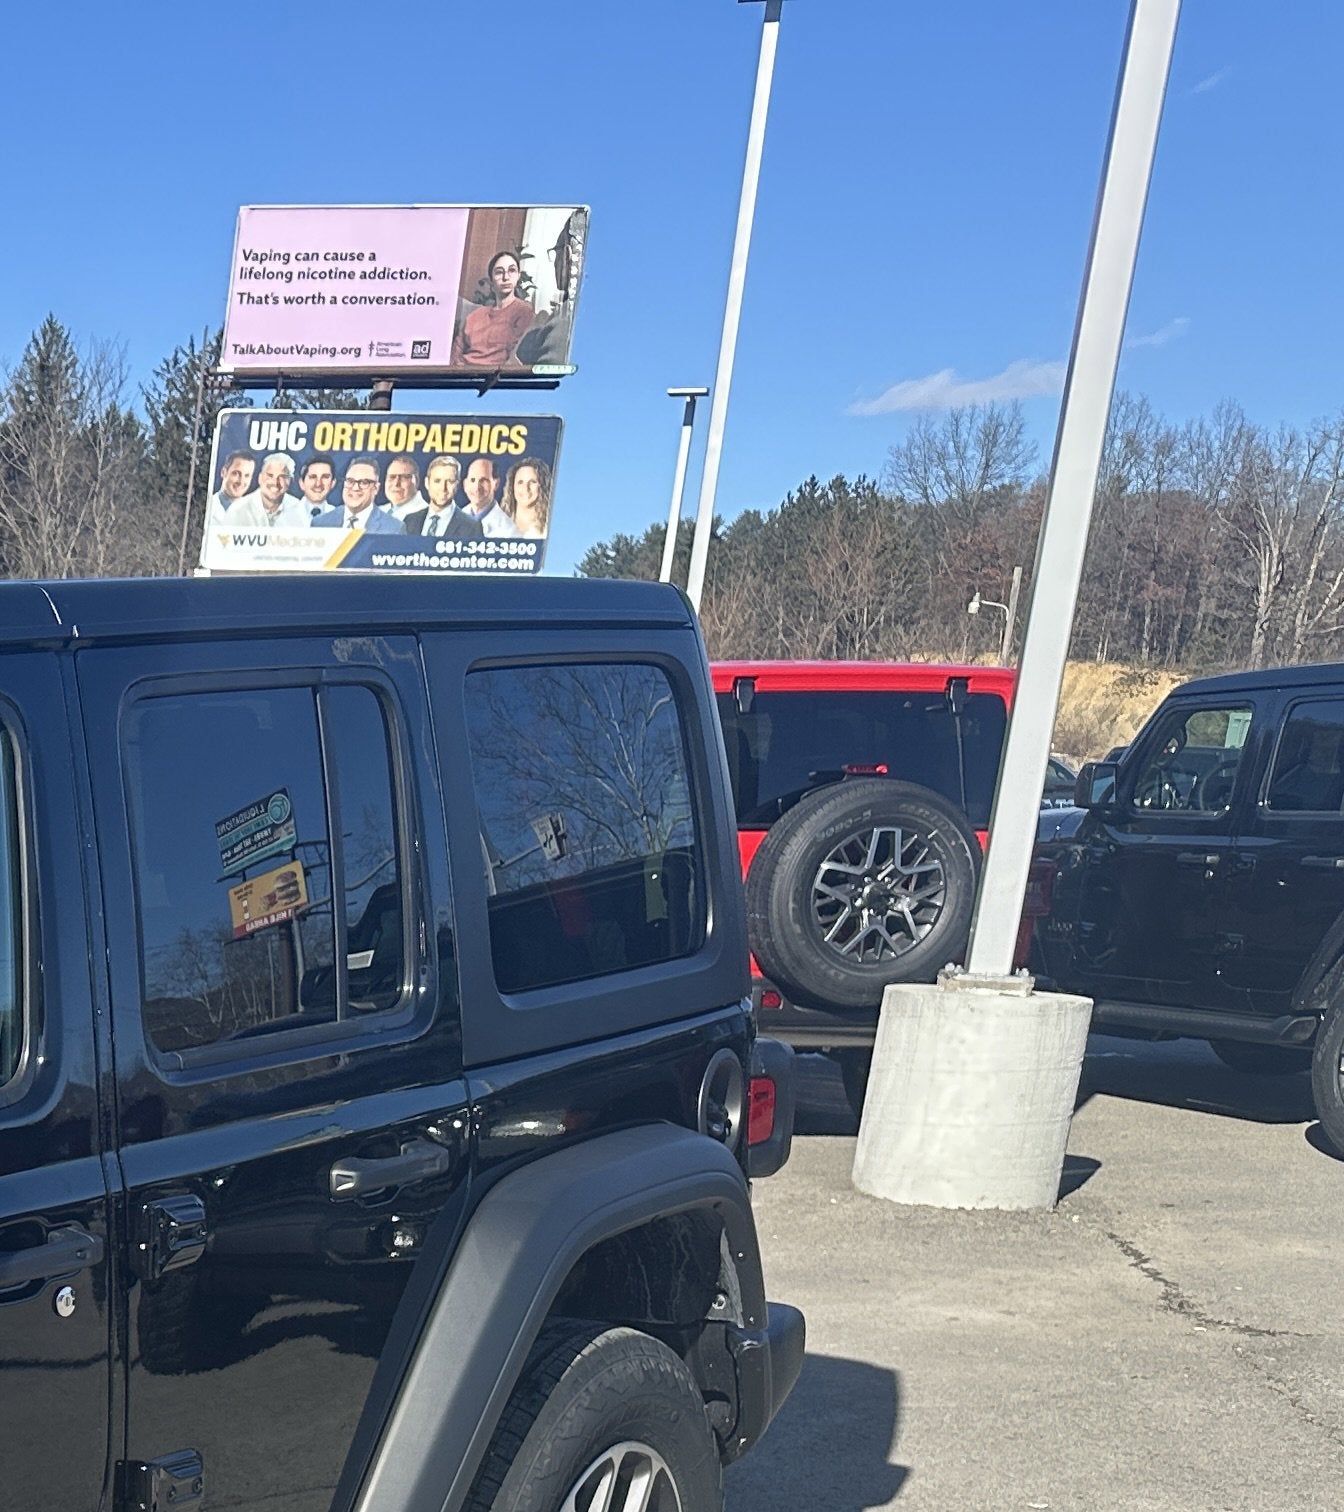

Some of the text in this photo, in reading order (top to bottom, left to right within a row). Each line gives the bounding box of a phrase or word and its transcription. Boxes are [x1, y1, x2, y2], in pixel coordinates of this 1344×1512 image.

[242, 249, 377, 264] Vaping can cause a
[239, 267, 432, 283] lifelong nicotine addiction.
[237, 292, 440, 306] That's worth a conversation.
[232, 343, 362, 358] TalkAboutVaping.org
[249, 420, 528, 455] UHC ORTHOPAEDICS
[232, 534, 267, 547] WVU
[371, 553, 535, 570] wvorthocenter.com
